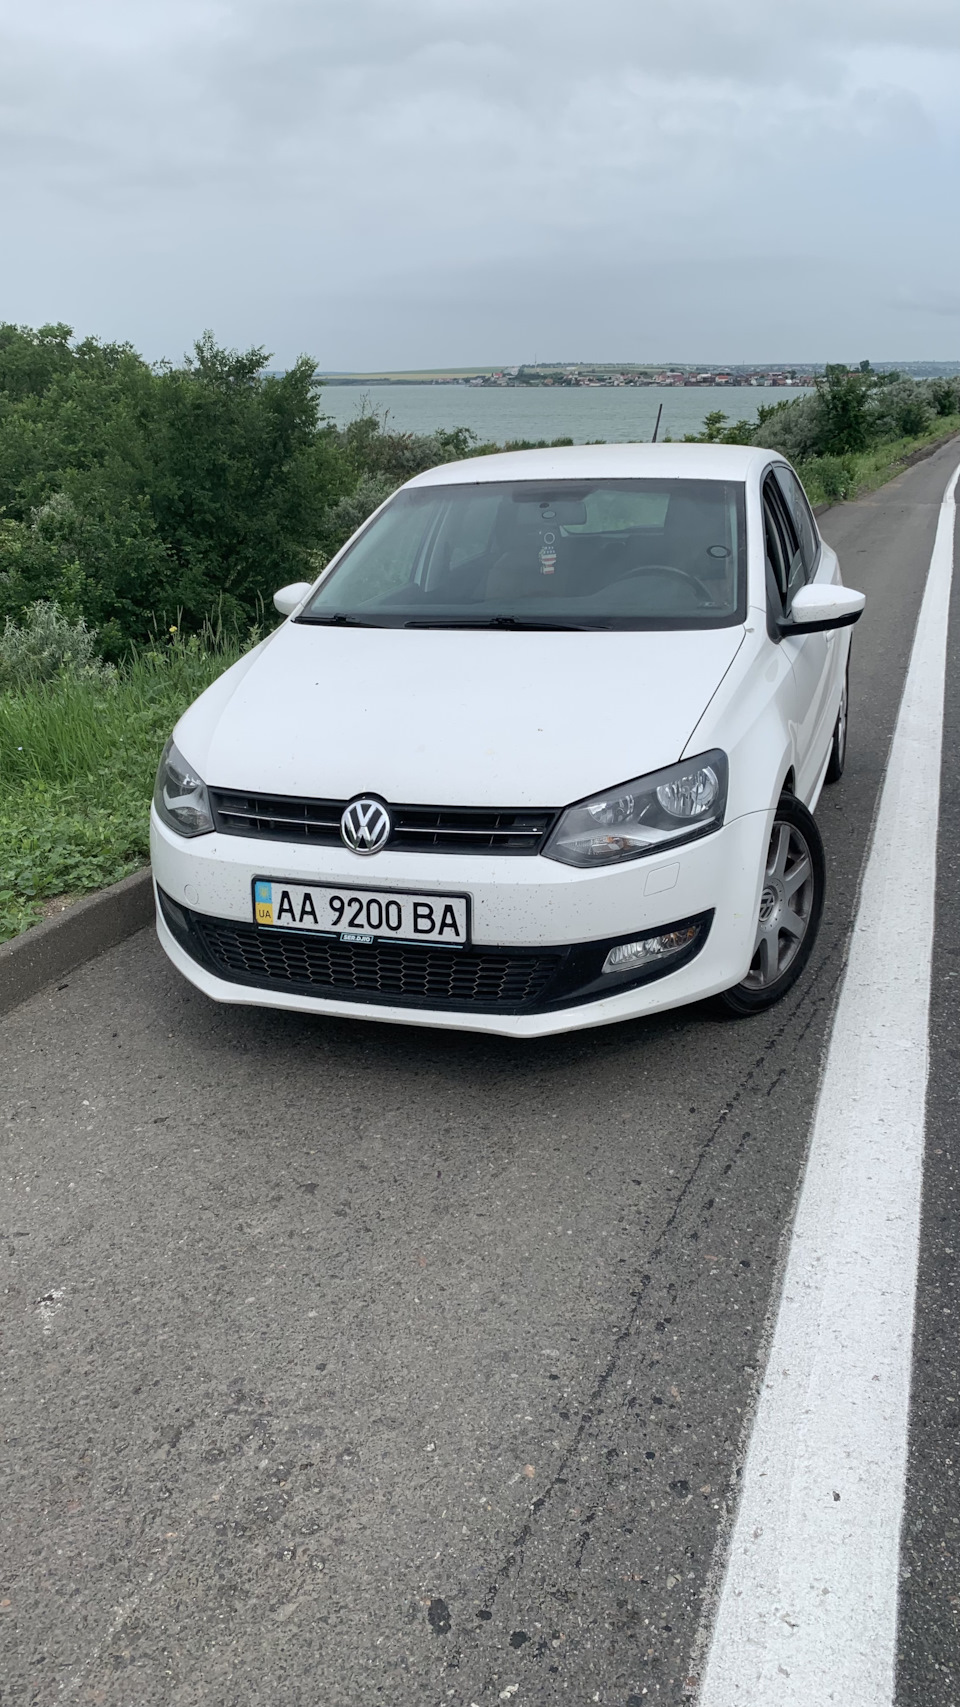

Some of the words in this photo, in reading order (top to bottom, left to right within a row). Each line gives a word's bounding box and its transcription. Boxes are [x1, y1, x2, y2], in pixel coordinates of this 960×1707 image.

[342, 800, 390, 852] VW
[258, 910, 271, 919] UA
[277, 890, 319, 924] AA
[328, 895, 403, 931] 9200
[413, 901, 461, 936] BA
